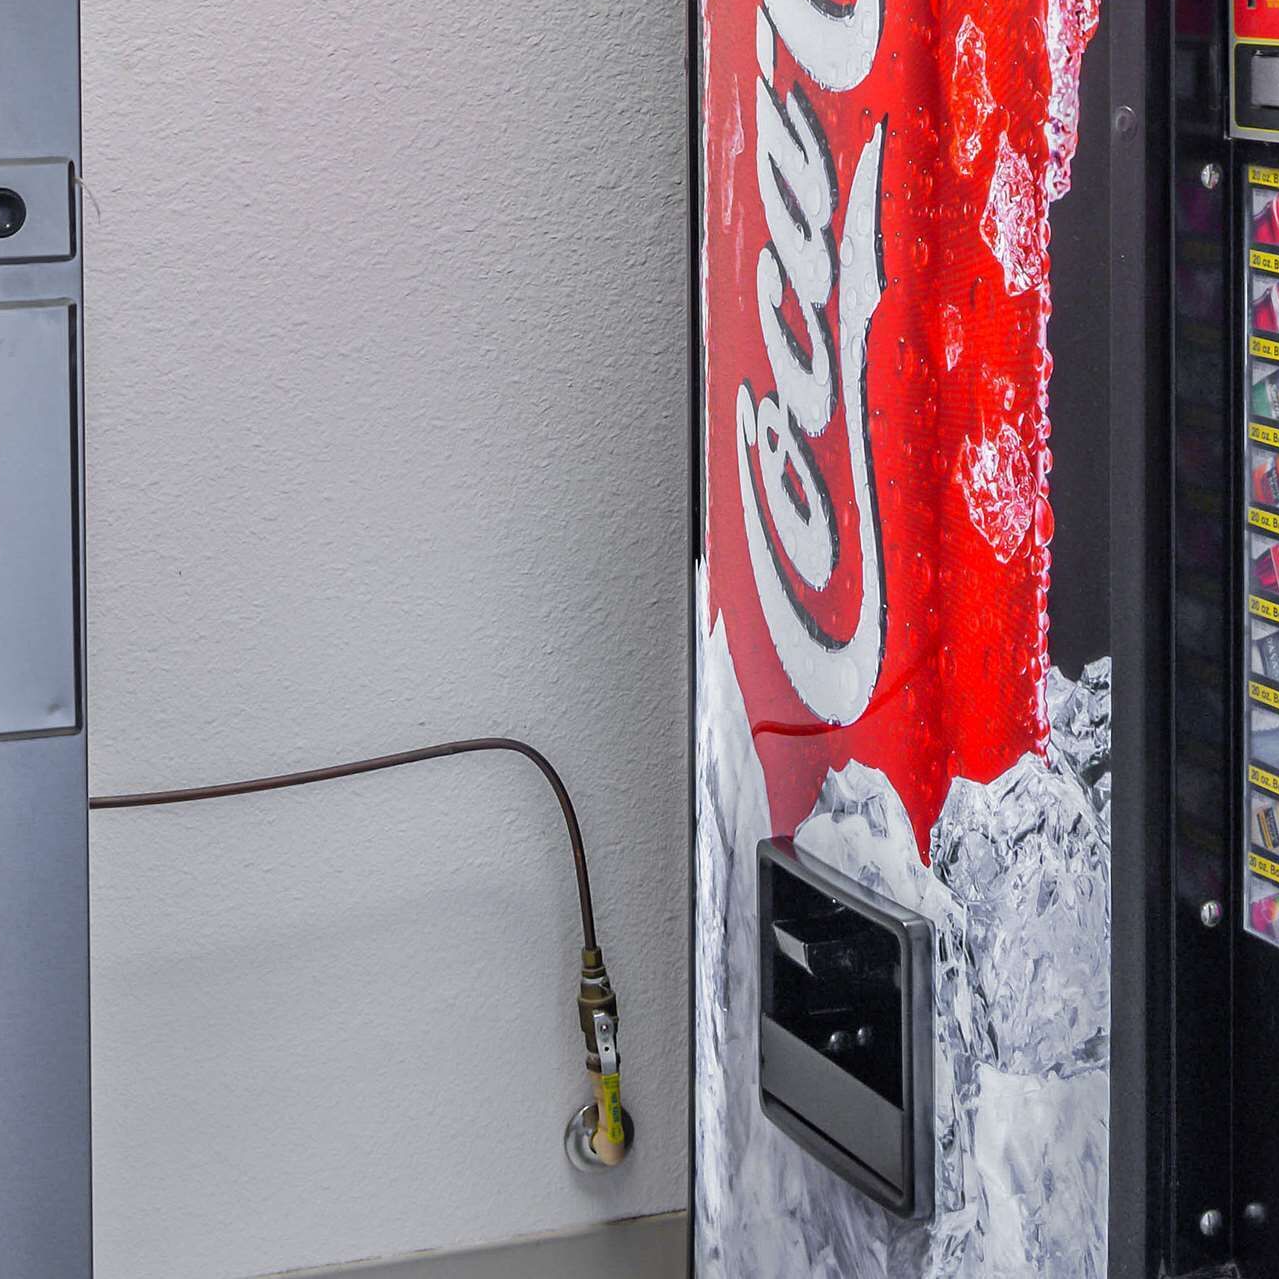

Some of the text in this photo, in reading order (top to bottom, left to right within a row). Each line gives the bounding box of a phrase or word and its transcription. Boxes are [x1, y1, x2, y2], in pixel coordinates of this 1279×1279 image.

[1263, 171, 1272, 180] oz.
[1252, 254, 1261, 265] 20
[1263, 258, 1273, 268] oz.
[1252, 341, 1261, 351] 20
[1263, 345, 1272, 354] oz.
[1251, 426, 1260, 436] 20
[1262, 431, 1271, 441] oz.
[1251, 510, 1260, 520] 20
[1261, 515, 1270, 524] oz.
[1251, 598, 1260, 609] 20
[1262, 603, 1271, 613] oz.
[1251, 683, 1260, 694] 20
[1262, 688, 1271, 698] oz.
[1250, 768, 1260, 779] 20
[1261, 773, 1271, 783] oz.
[1259, 859, 1269, 873] oz.
